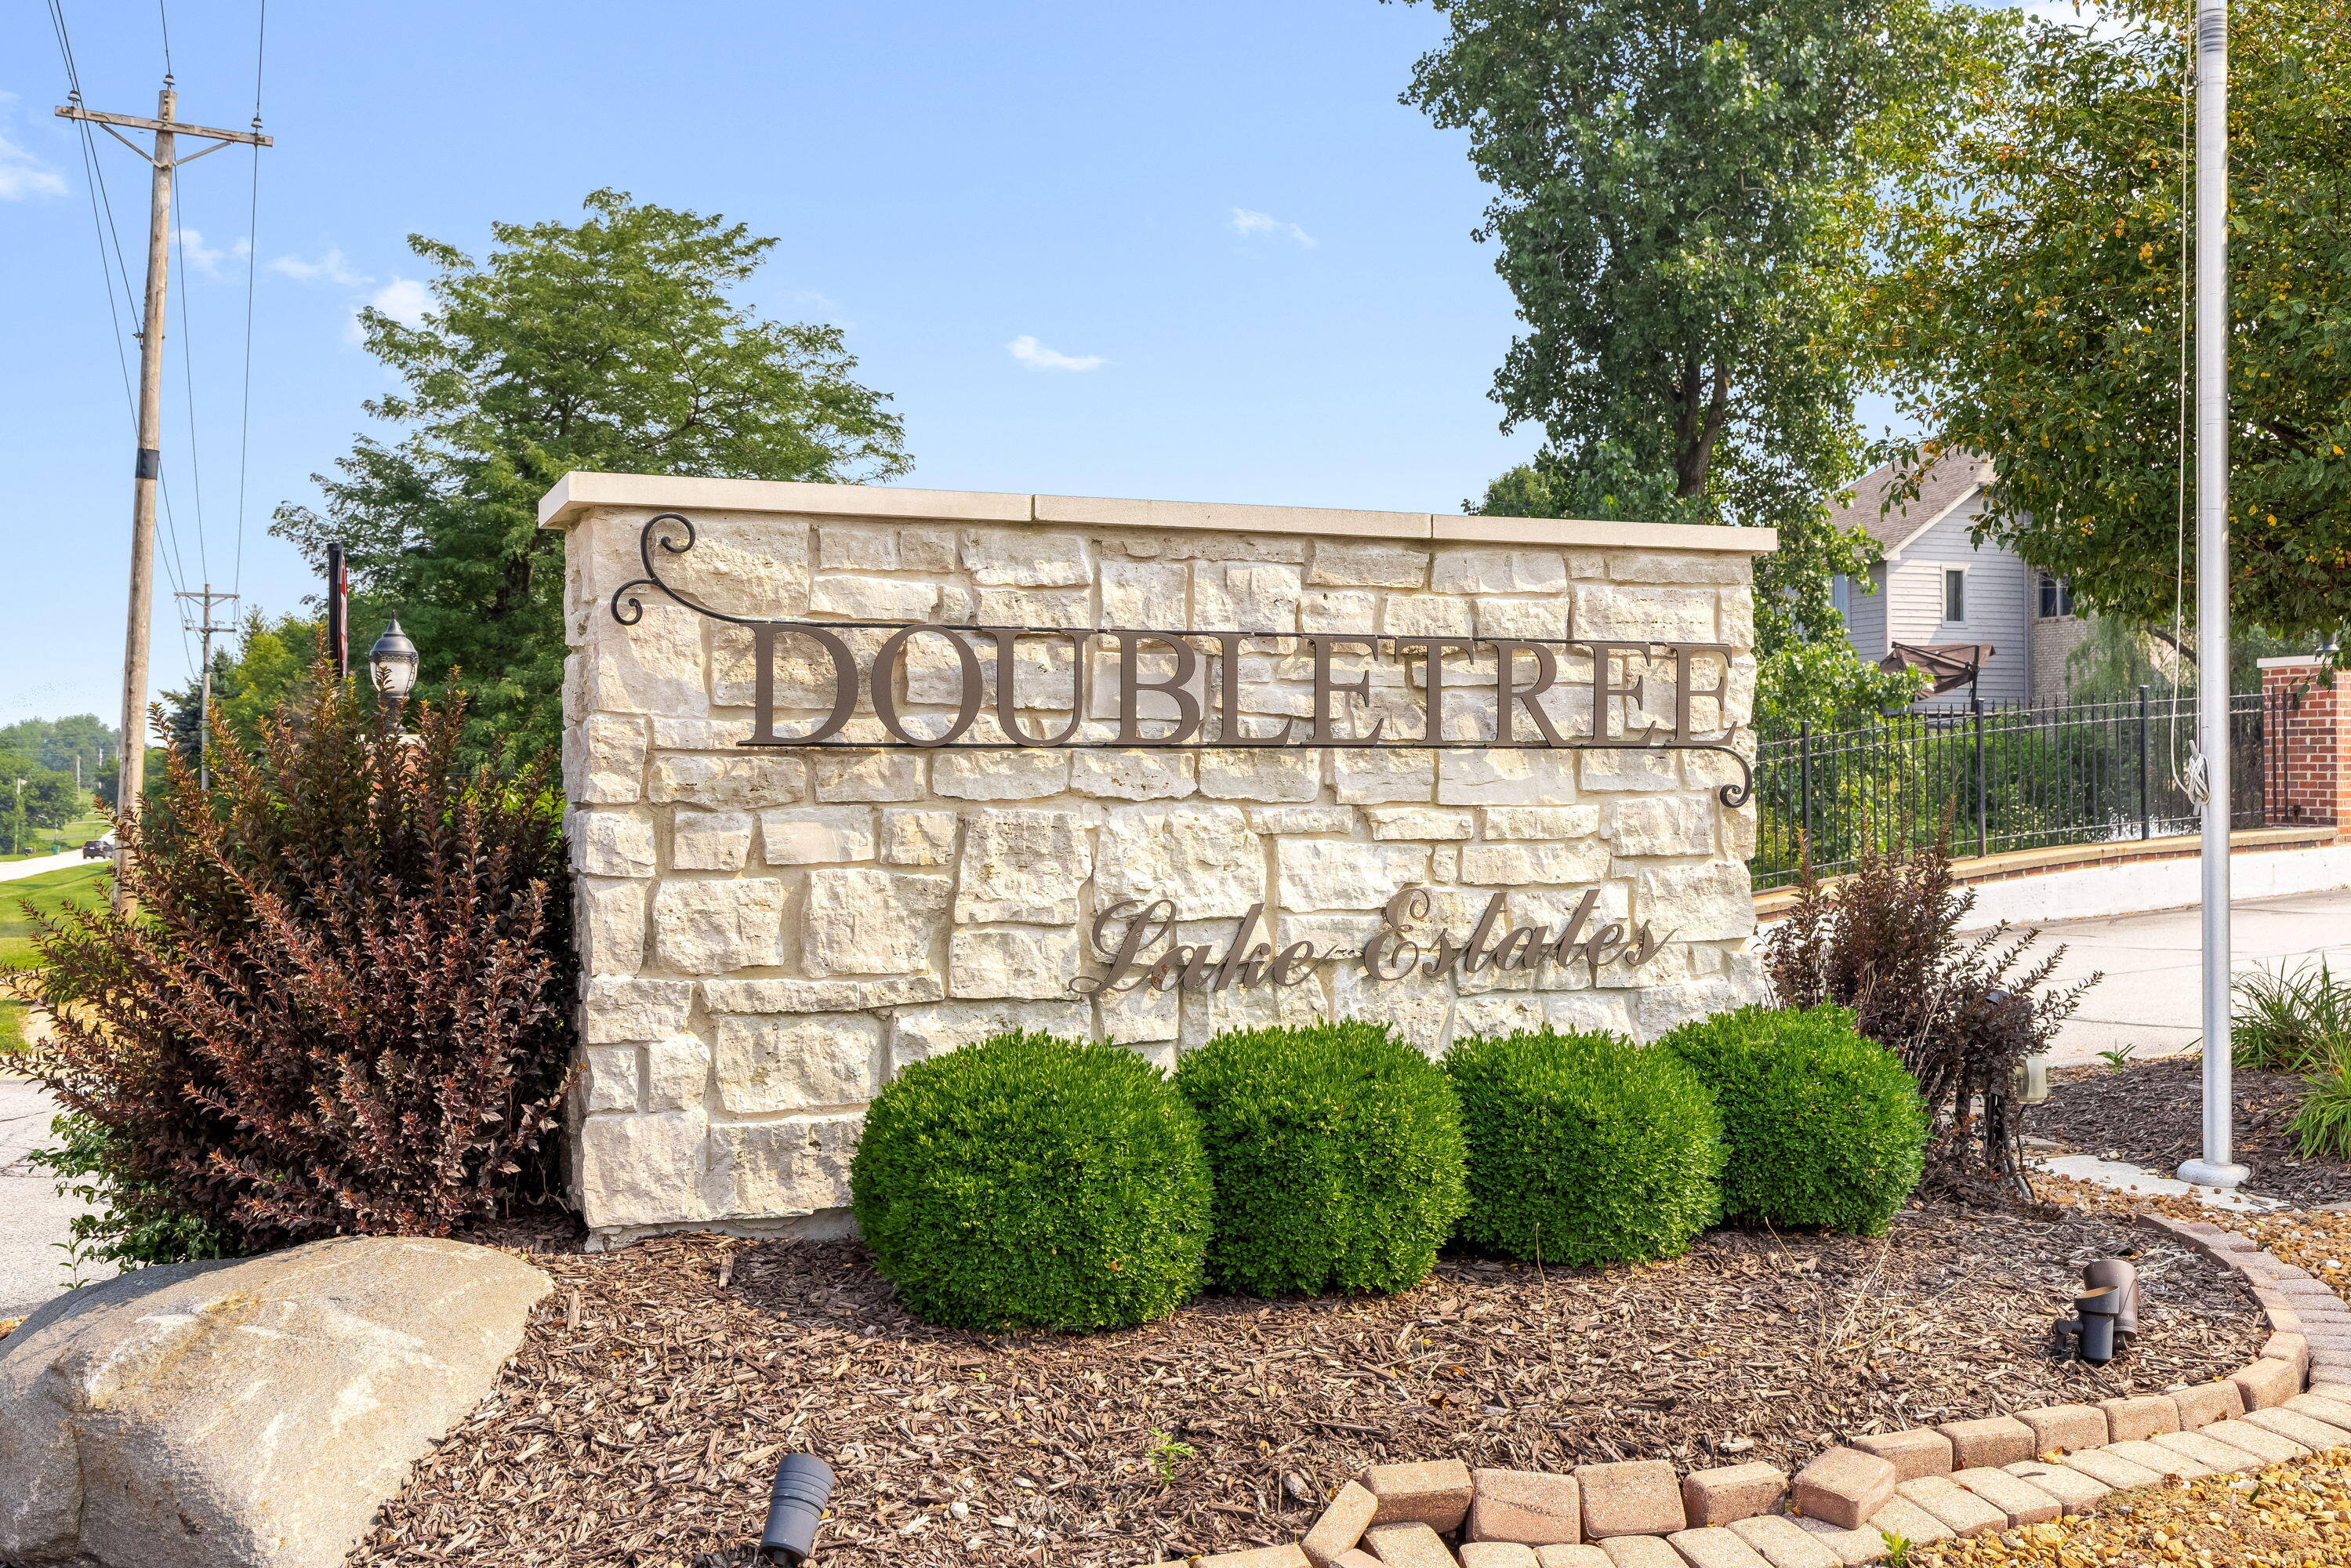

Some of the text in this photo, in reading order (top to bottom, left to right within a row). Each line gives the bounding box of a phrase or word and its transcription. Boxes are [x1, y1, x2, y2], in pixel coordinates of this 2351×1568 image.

[739, 625, 1739, 748] DOUBLETREE
[1068, 887, 1679, 993] Lake Estates
